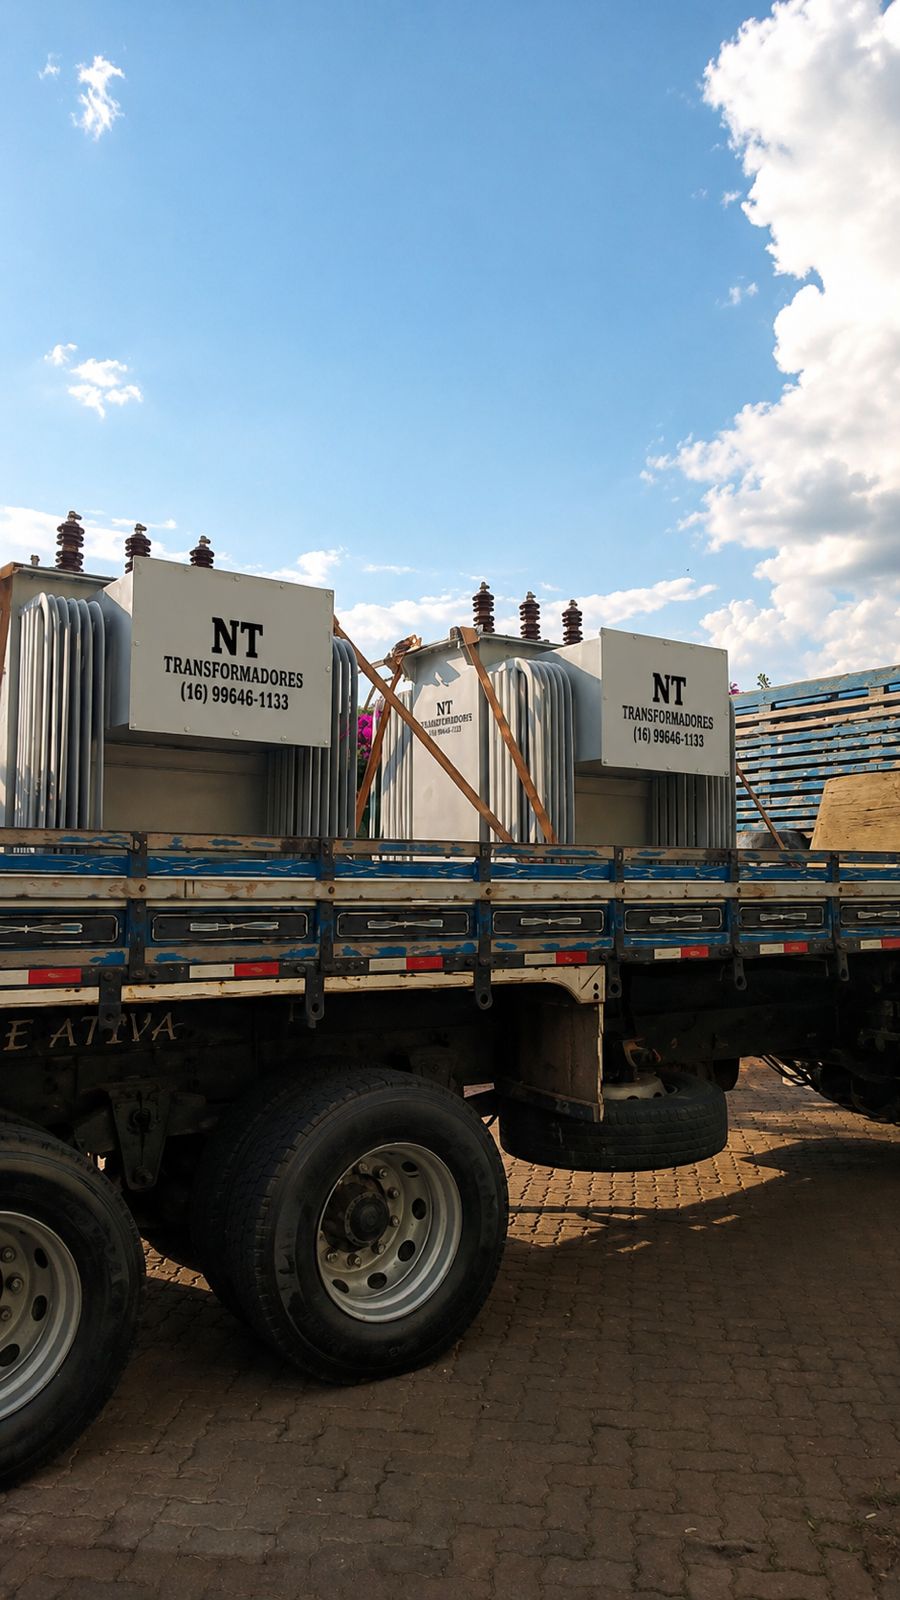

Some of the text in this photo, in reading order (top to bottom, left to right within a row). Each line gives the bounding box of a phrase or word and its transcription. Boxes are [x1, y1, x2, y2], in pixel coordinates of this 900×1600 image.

[211, 617, 263, 658] NT
[164, 655, 304, 689] TRANSFORMADORES
[180, 681, 289, 710] (16) 99646-1133
[652, 672, 686, 706] NT
[436, 700, 453, 716] NT
[622, 705, 714, 730] TRANSFORMADORES
[633, 726, 704, 747] (16) 99646-1133
